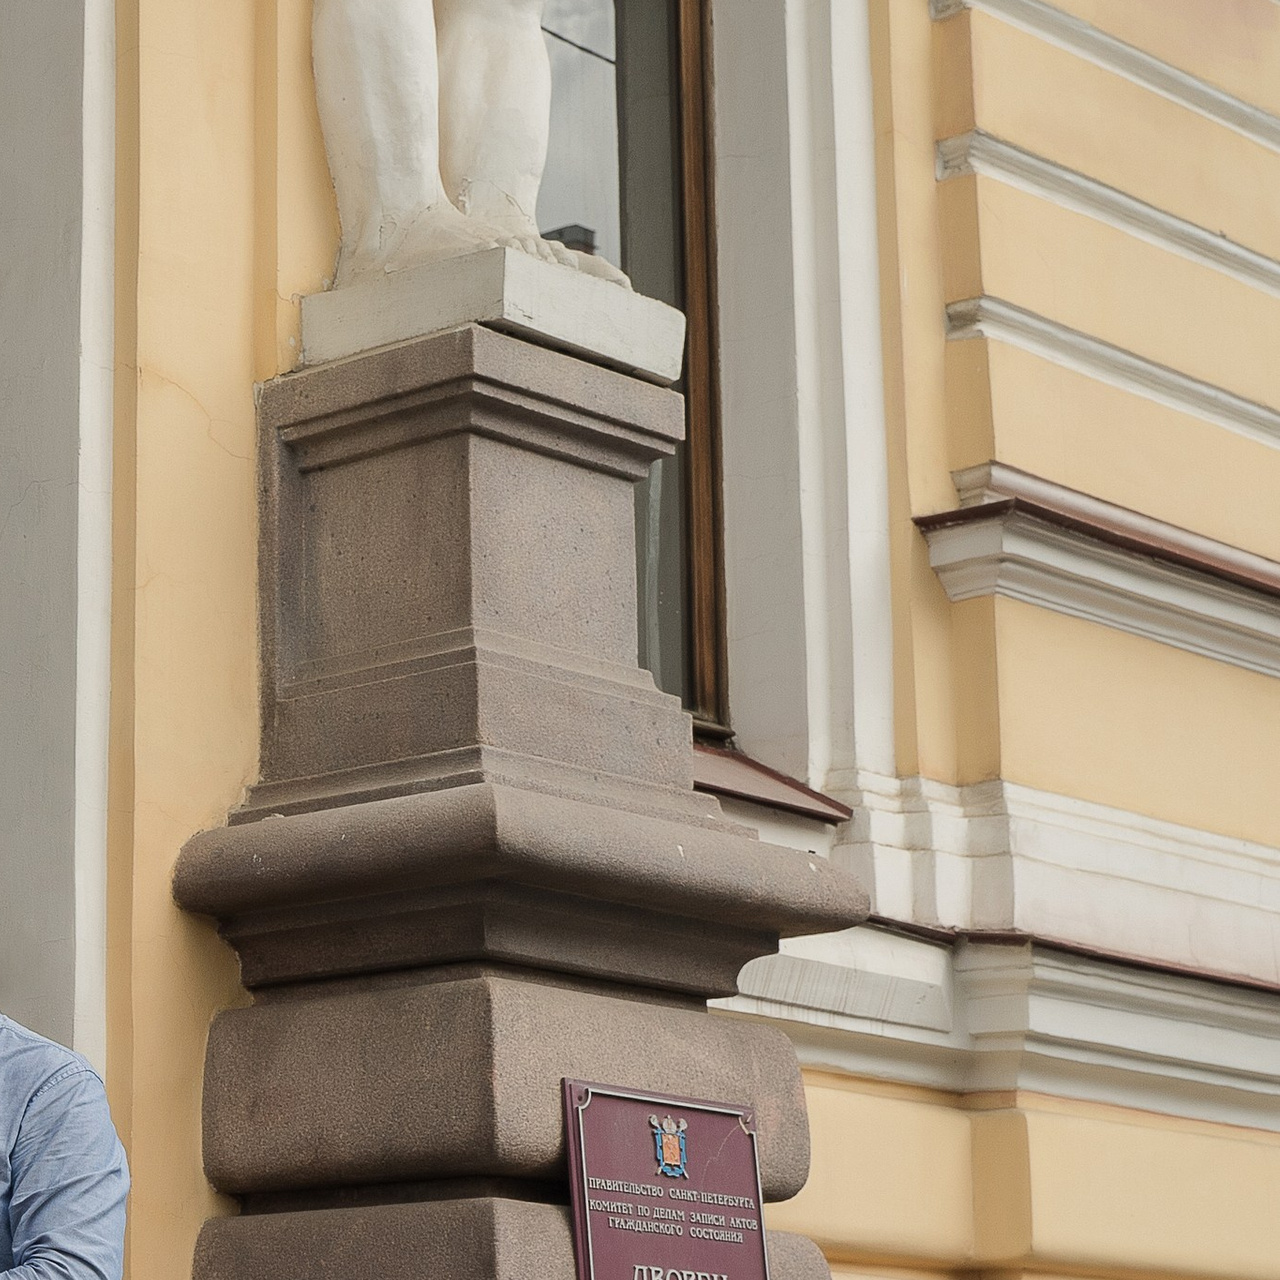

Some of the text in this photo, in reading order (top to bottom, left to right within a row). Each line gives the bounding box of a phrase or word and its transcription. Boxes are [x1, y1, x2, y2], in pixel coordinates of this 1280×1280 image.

[588, 1177, 755, 1209] ПРАВИТЕЛЬСТВО САНКТ-ПЕТЕРБУРГА
[589, 1199, 758, 1230] КОМИТЕТ ПО ДЕЛАМ ЗАПИСИ АКТОВ
[608, 1217, 743, 1243] ГРАЖДАНСКОГО СОСТОЯНИЯ
